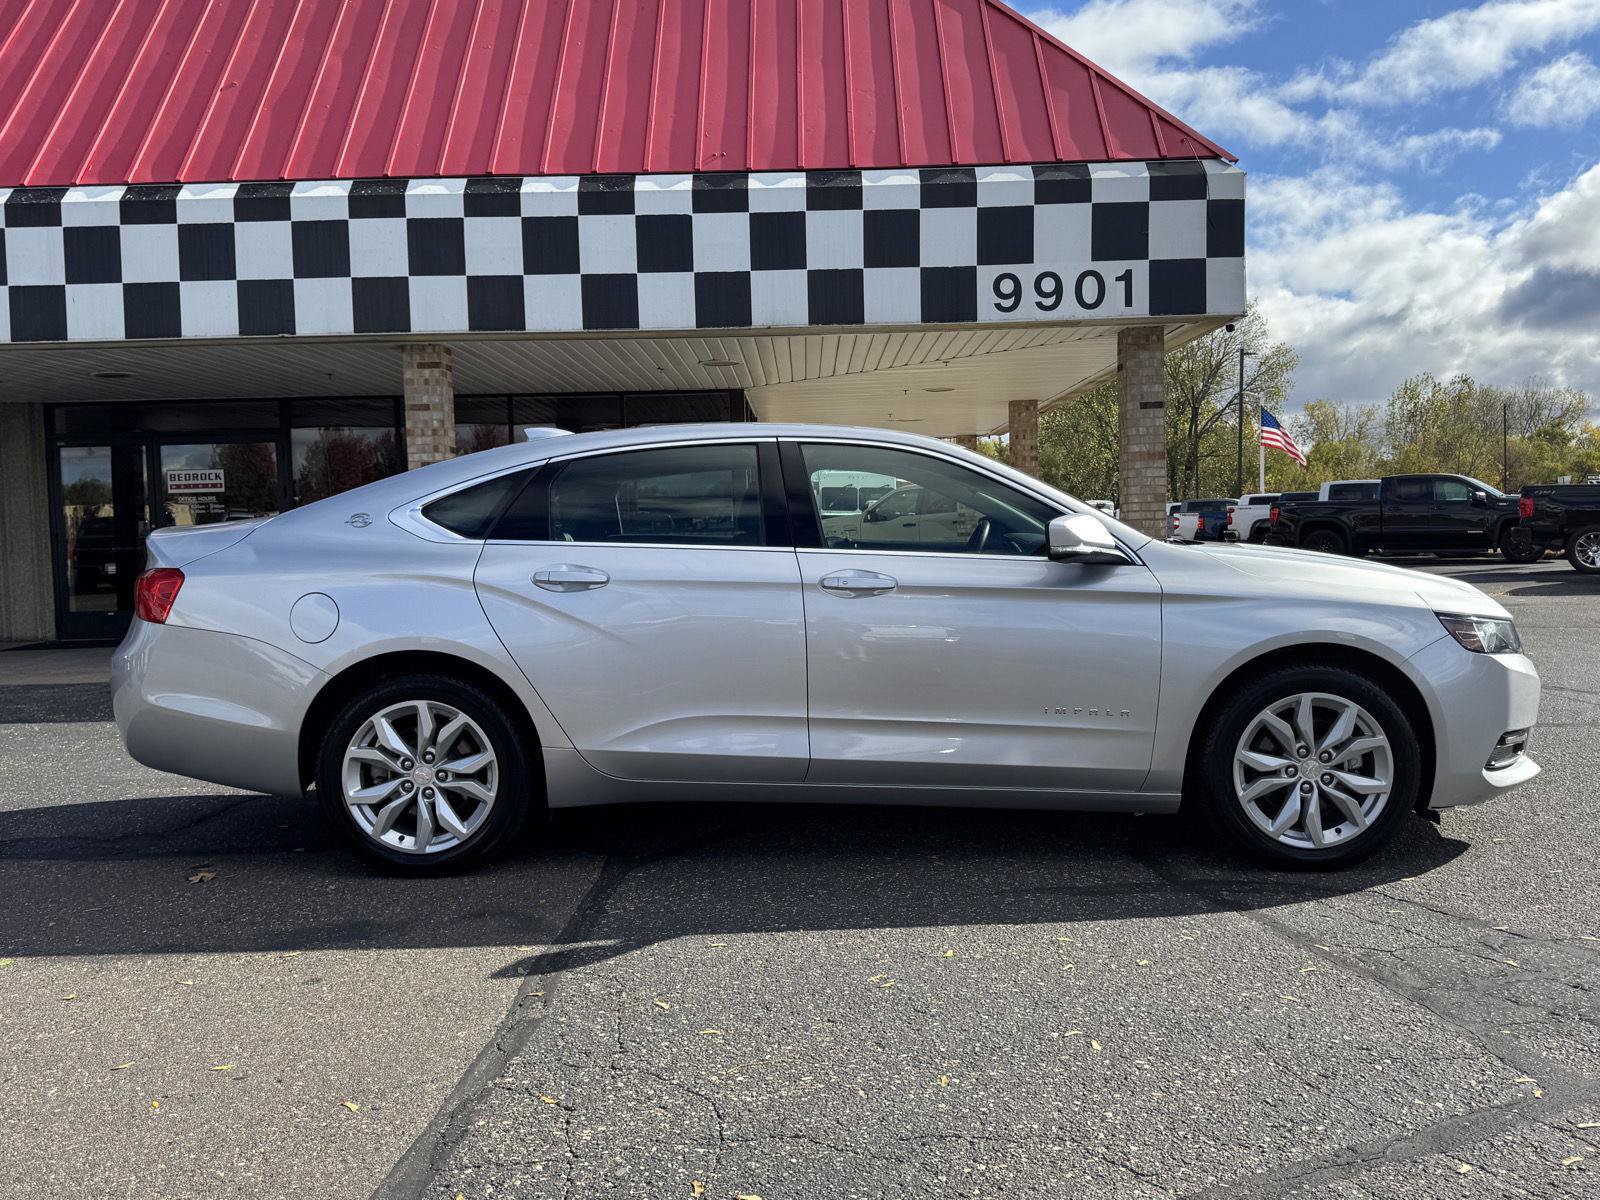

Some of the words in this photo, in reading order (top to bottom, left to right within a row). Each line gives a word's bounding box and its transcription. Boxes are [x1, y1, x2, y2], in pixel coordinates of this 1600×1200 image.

[992, 269, 1133, 313] 9901
[169, 472, 222, 482] BEDROCK
[1043, 706, 1131, 718] IMPALA
